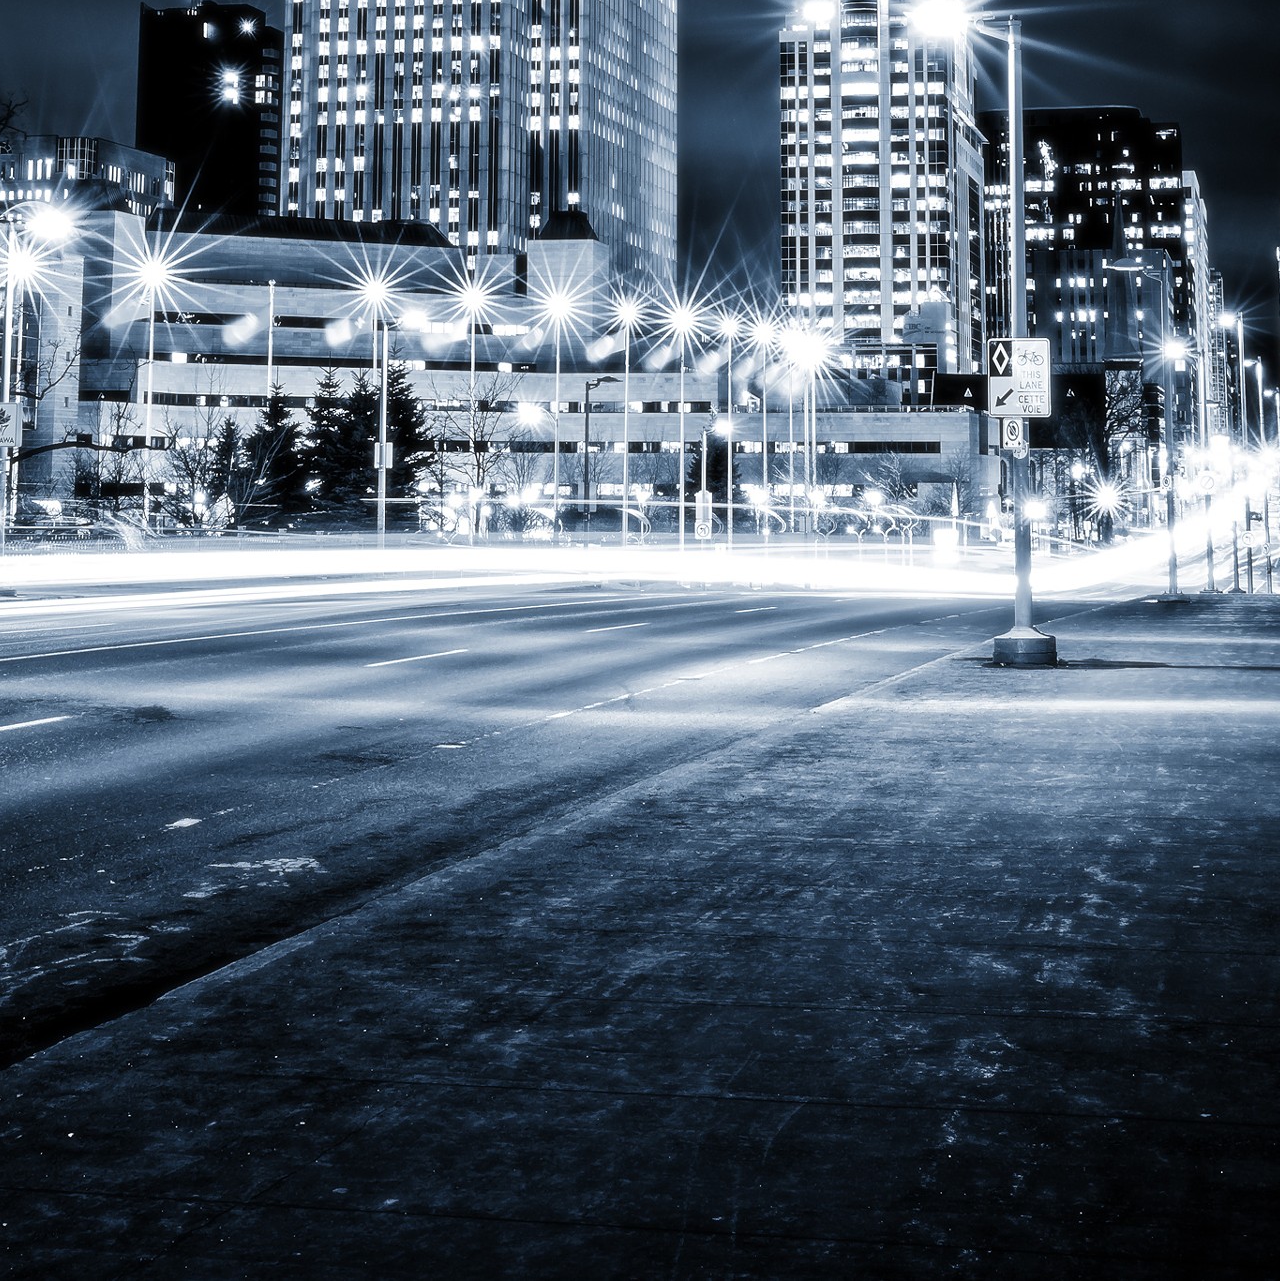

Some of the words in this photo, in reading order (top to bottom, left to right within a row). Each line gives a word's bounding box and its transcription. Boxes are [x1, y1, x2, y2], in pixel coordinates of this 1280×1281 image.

[1022, 370, 1041, 379] THIS
[1020, 381, 1043, 389] LANE
[1018, 395, 1045, 404] CETTE
[1022, 405, 1042, 414] VOIE
